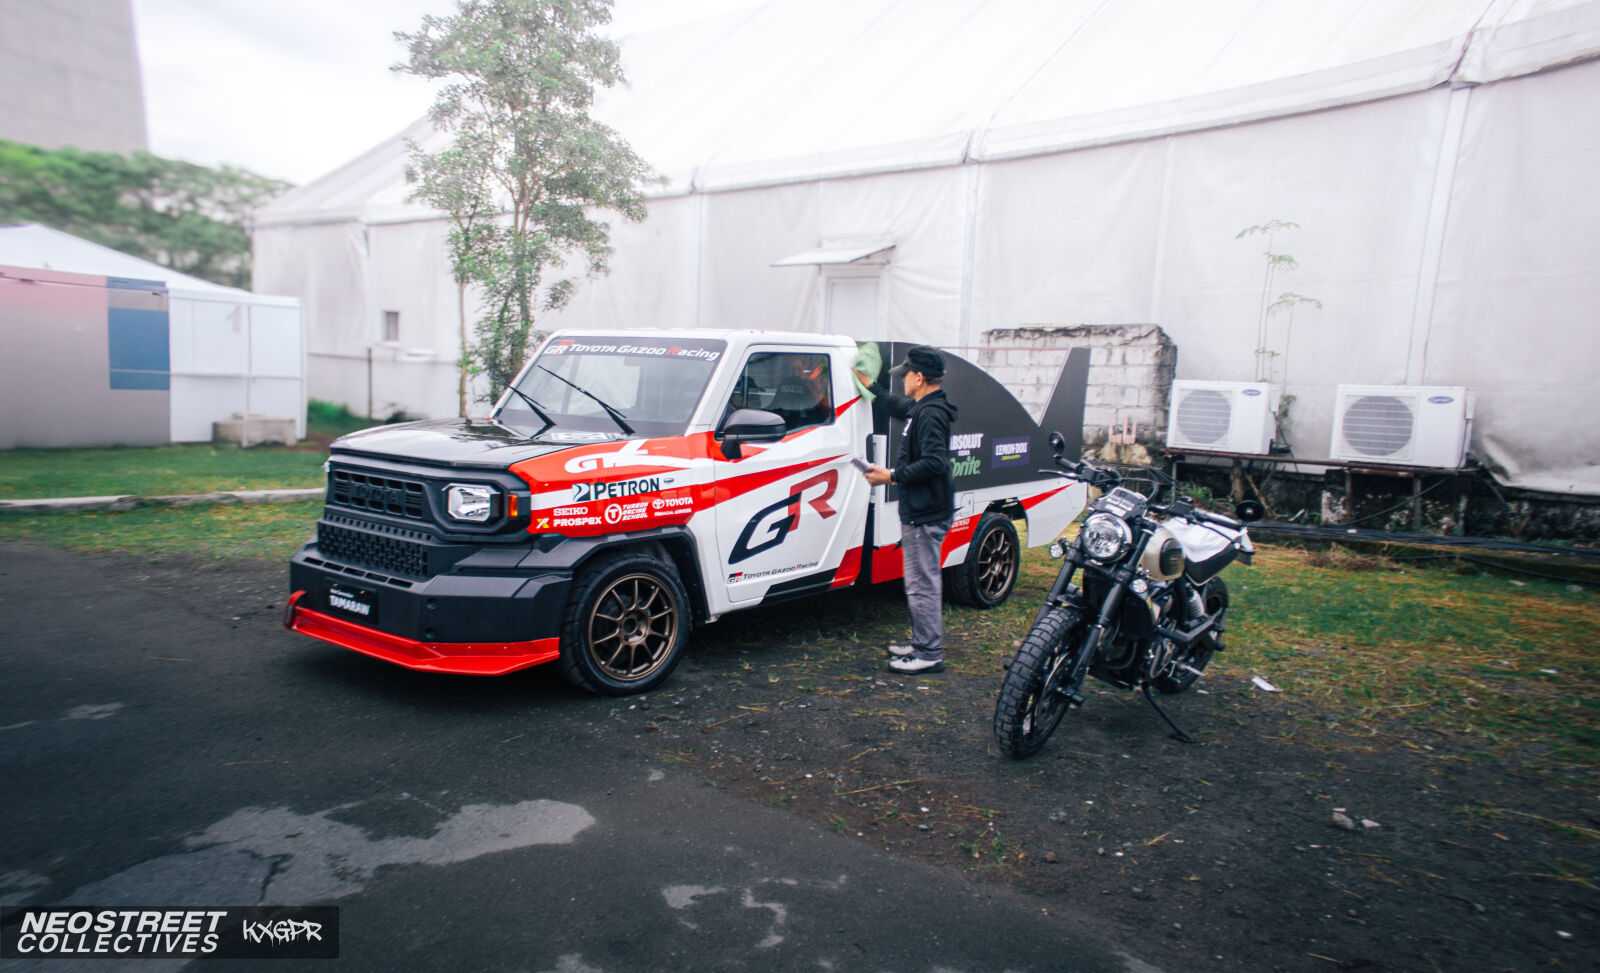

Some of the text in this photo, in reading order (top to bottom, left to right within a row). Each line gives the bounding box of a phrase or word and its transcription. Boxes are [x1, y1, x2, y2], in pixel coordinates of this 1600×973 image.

[569, 343, 616, 353] TOYOTA
[617, 345, 666, 355] GAZOO
[666, 346, 721, 361] Racing
[594, 477, 660, 500] PETRON
[665, 497, 693, 507] TOYOTA
[553, 506, 588, 517] SEIKO
[728, 468, 839, 565] GR
[553, 516, 602, 527] PROSPEX
[743, 571, 770, 579] TOYOTA
